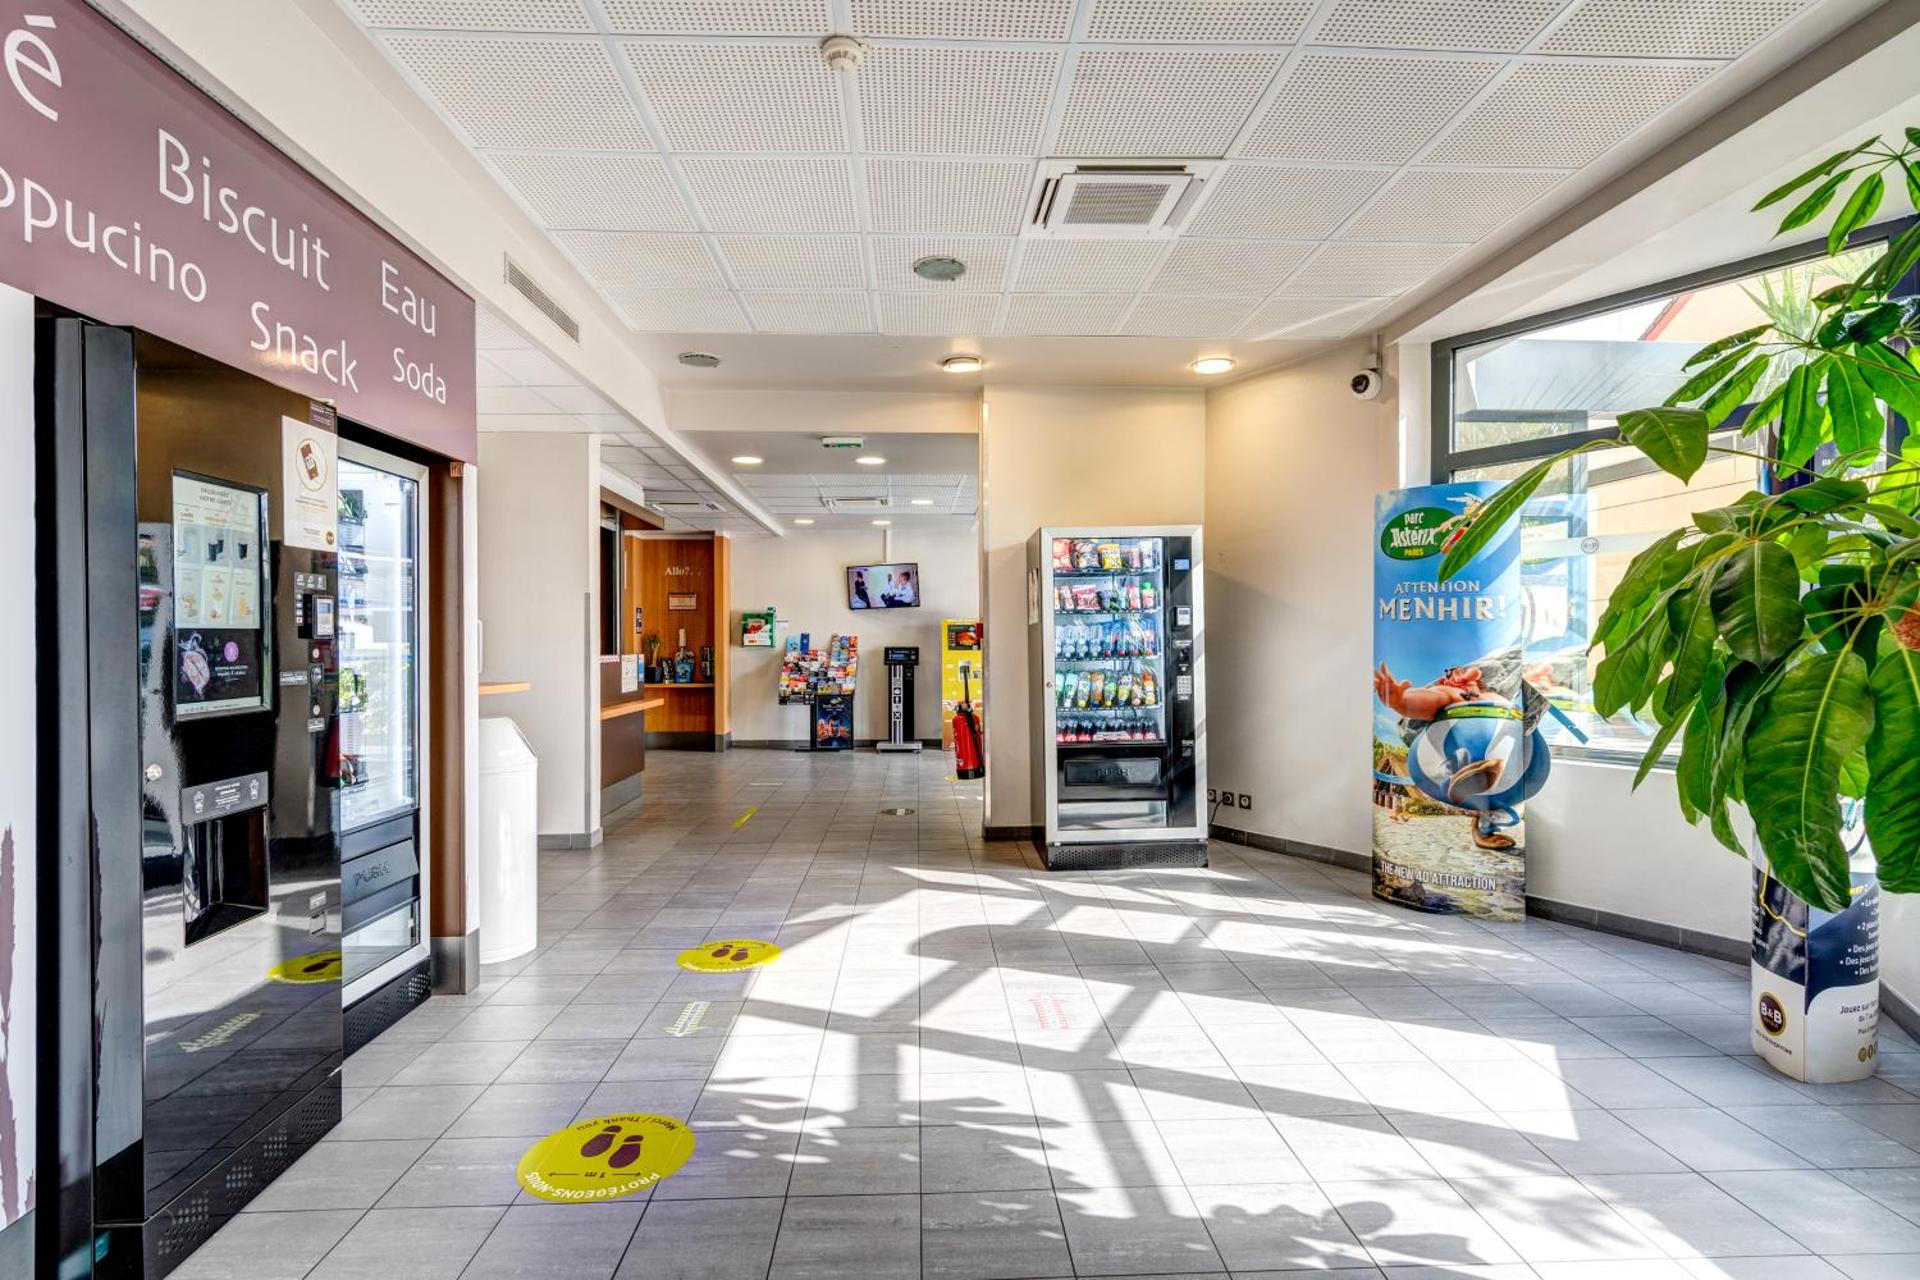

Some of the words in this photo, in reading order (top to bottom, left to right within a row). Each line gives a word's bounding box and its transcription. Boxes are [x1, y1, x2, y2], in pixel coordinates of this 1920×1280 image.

[4, 14, 62, 122] é
[158, 128, 330, 292] Biscuit
[381, 260, 436, 337] Eau
[250, 301, 359, 394] Snack
[392, 347, 446, 405] Soda
[1404, 512, 1424, 526] parc
[1390, 526, 1436, 548] Astérix
[1394, 580, 1480, 594] ATTENTION
[1379, 595, 1506, 622] MENHIR!
[1381, 860, 1394, 875] THE
[1394, 866, 1414, 880] NEW
[1416, 870, 1429, 883] 4D
[1431, 872, 1497, 891] ATTRACTION
[1760, 1001, 1783, 1025] B&B
[576, 1121, 600, 1131] you
[603, 1117, 641, 1125] Thank
[652, 1118, 678, 1131] Merci
[525, 1170, 661, 1199] PROTÉGEONS-NOUS
